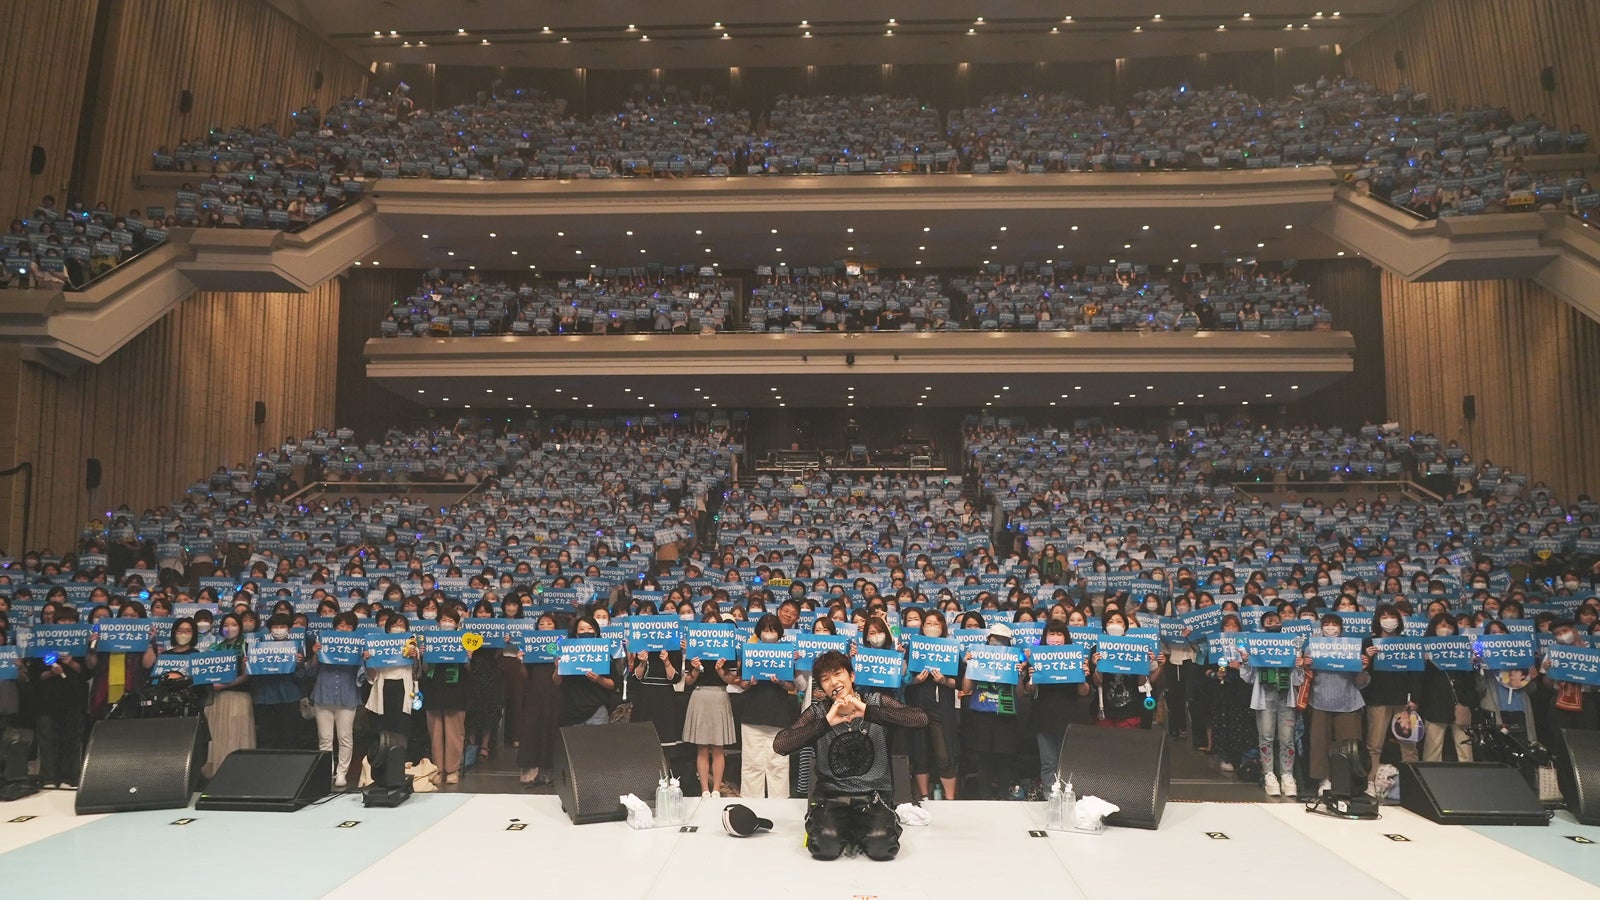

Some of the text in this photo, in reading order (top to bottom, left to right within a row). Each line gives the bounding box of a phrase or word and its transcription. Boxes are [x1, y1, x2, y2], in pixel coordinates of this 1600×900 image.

[1184, 610, 1222, 624] WOOYOUNG
[100, 624, 150, 632] WOOYOUNG
[632, 622, 678, 630] WOOYOUNG
[1282, 625, 1311, 633] OYOUNG
[100, 632, 149, 640] 待ってたよ！
[633, 631, 678, 639] 待ってたよ！
[690, 629, 734, 638] WOOYOUNG
[322, 637, 365, 645] WOOYOUNG
[689, 639, 734, 647] 待ってたよ！
[798, 640, 845, 649] WOOYOUNG
[562, 645, 608, 653] WOOYOUNG
[912, 641, 958, 652] WOOYOUNG
[1100, 642, 1148, 652] WOOYOUNG
[1377, 643, 1422, 651] WOOYOUNG
[192, 655, 237, 665] WOOYOUNG
[249, 654, 295, 663] 待ってたよ！
[561, 654, 608, 663] 待ってたよ！
[855, 654, 902, 665] WOOYOUNG
[912, 651, 957, 662] 待ってたよ！
[971, 650, 1018, 662] WOOYOUNG
[1033, 652, 1082, 660] WOOYOUNG
[1100, 651, 1147, 662] 待ってたよ！
[1550, 651, 1600, 663] WOOYOUN
[745, 660, 792, 668] 待ってたよ！
[192, 664, 236, 675] 待ってたよ！
[855, 663, 900, 675] 待ってたよ！
